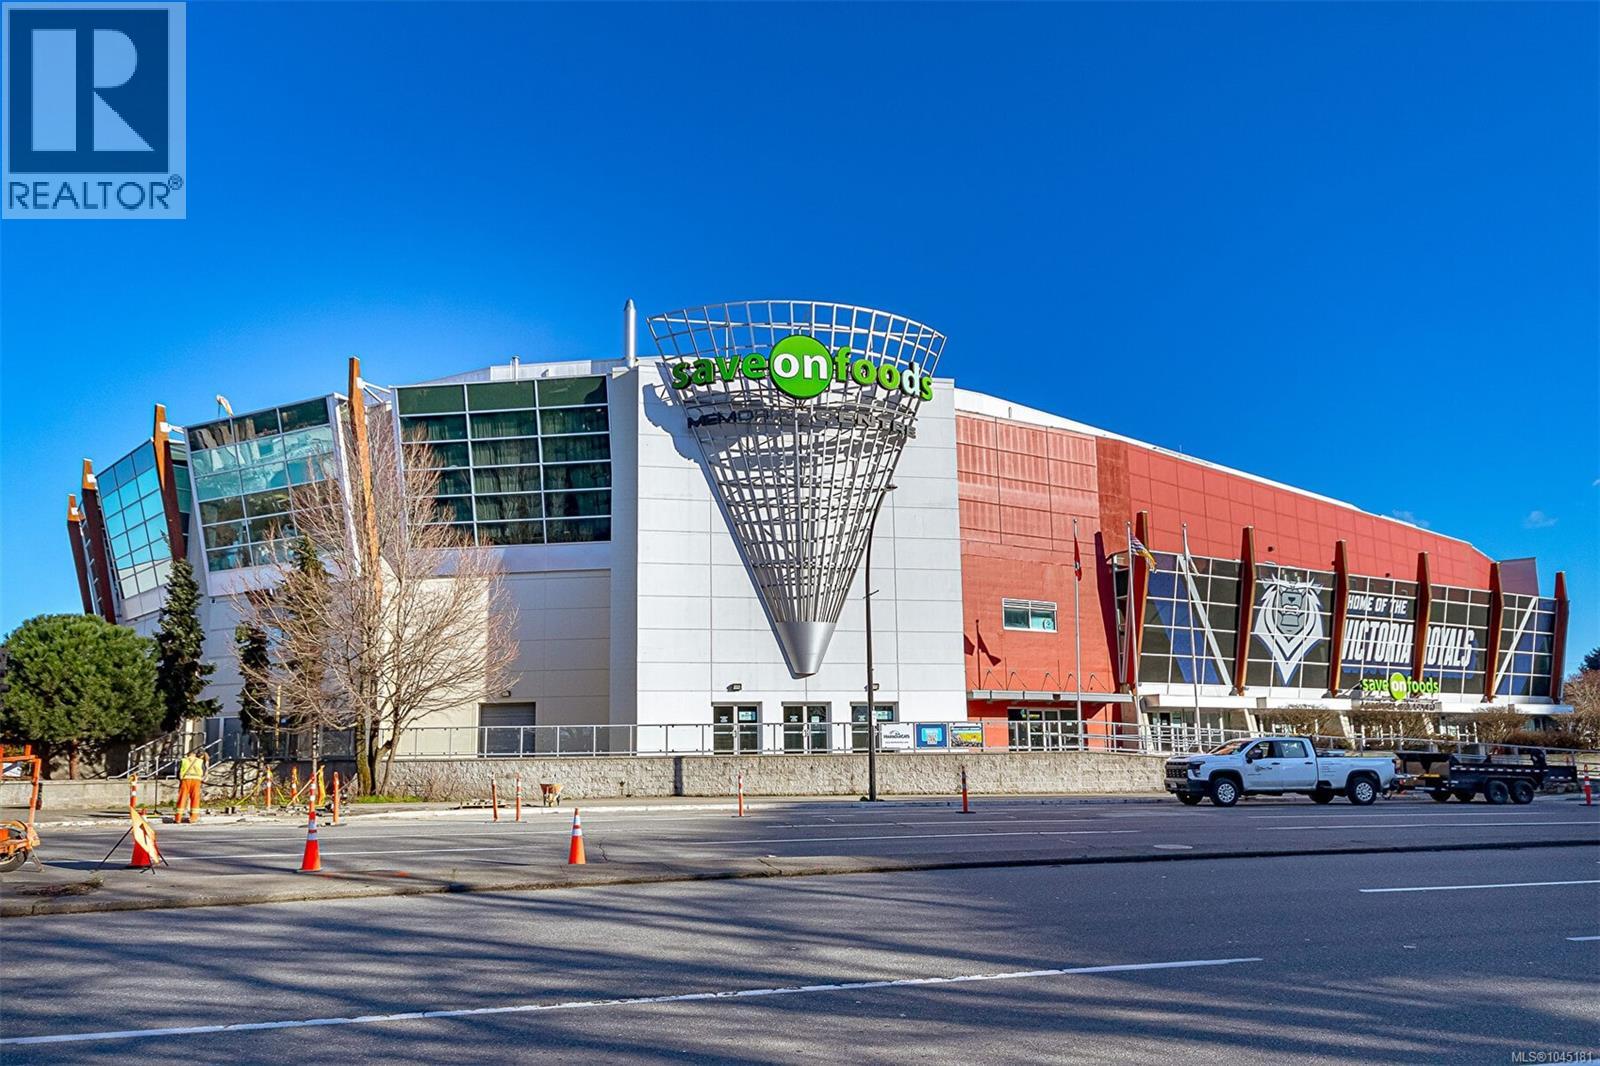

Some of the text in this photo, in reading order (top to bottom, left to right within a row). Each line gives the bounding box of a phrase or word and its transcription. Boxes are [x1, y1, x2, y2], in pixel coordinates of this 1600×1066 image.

[687, 408, 812, 430] MEMOR
[1347, 594, 1408, 615] HOME OF THE
[1341, 619, 1414, 664] VICTORIA
